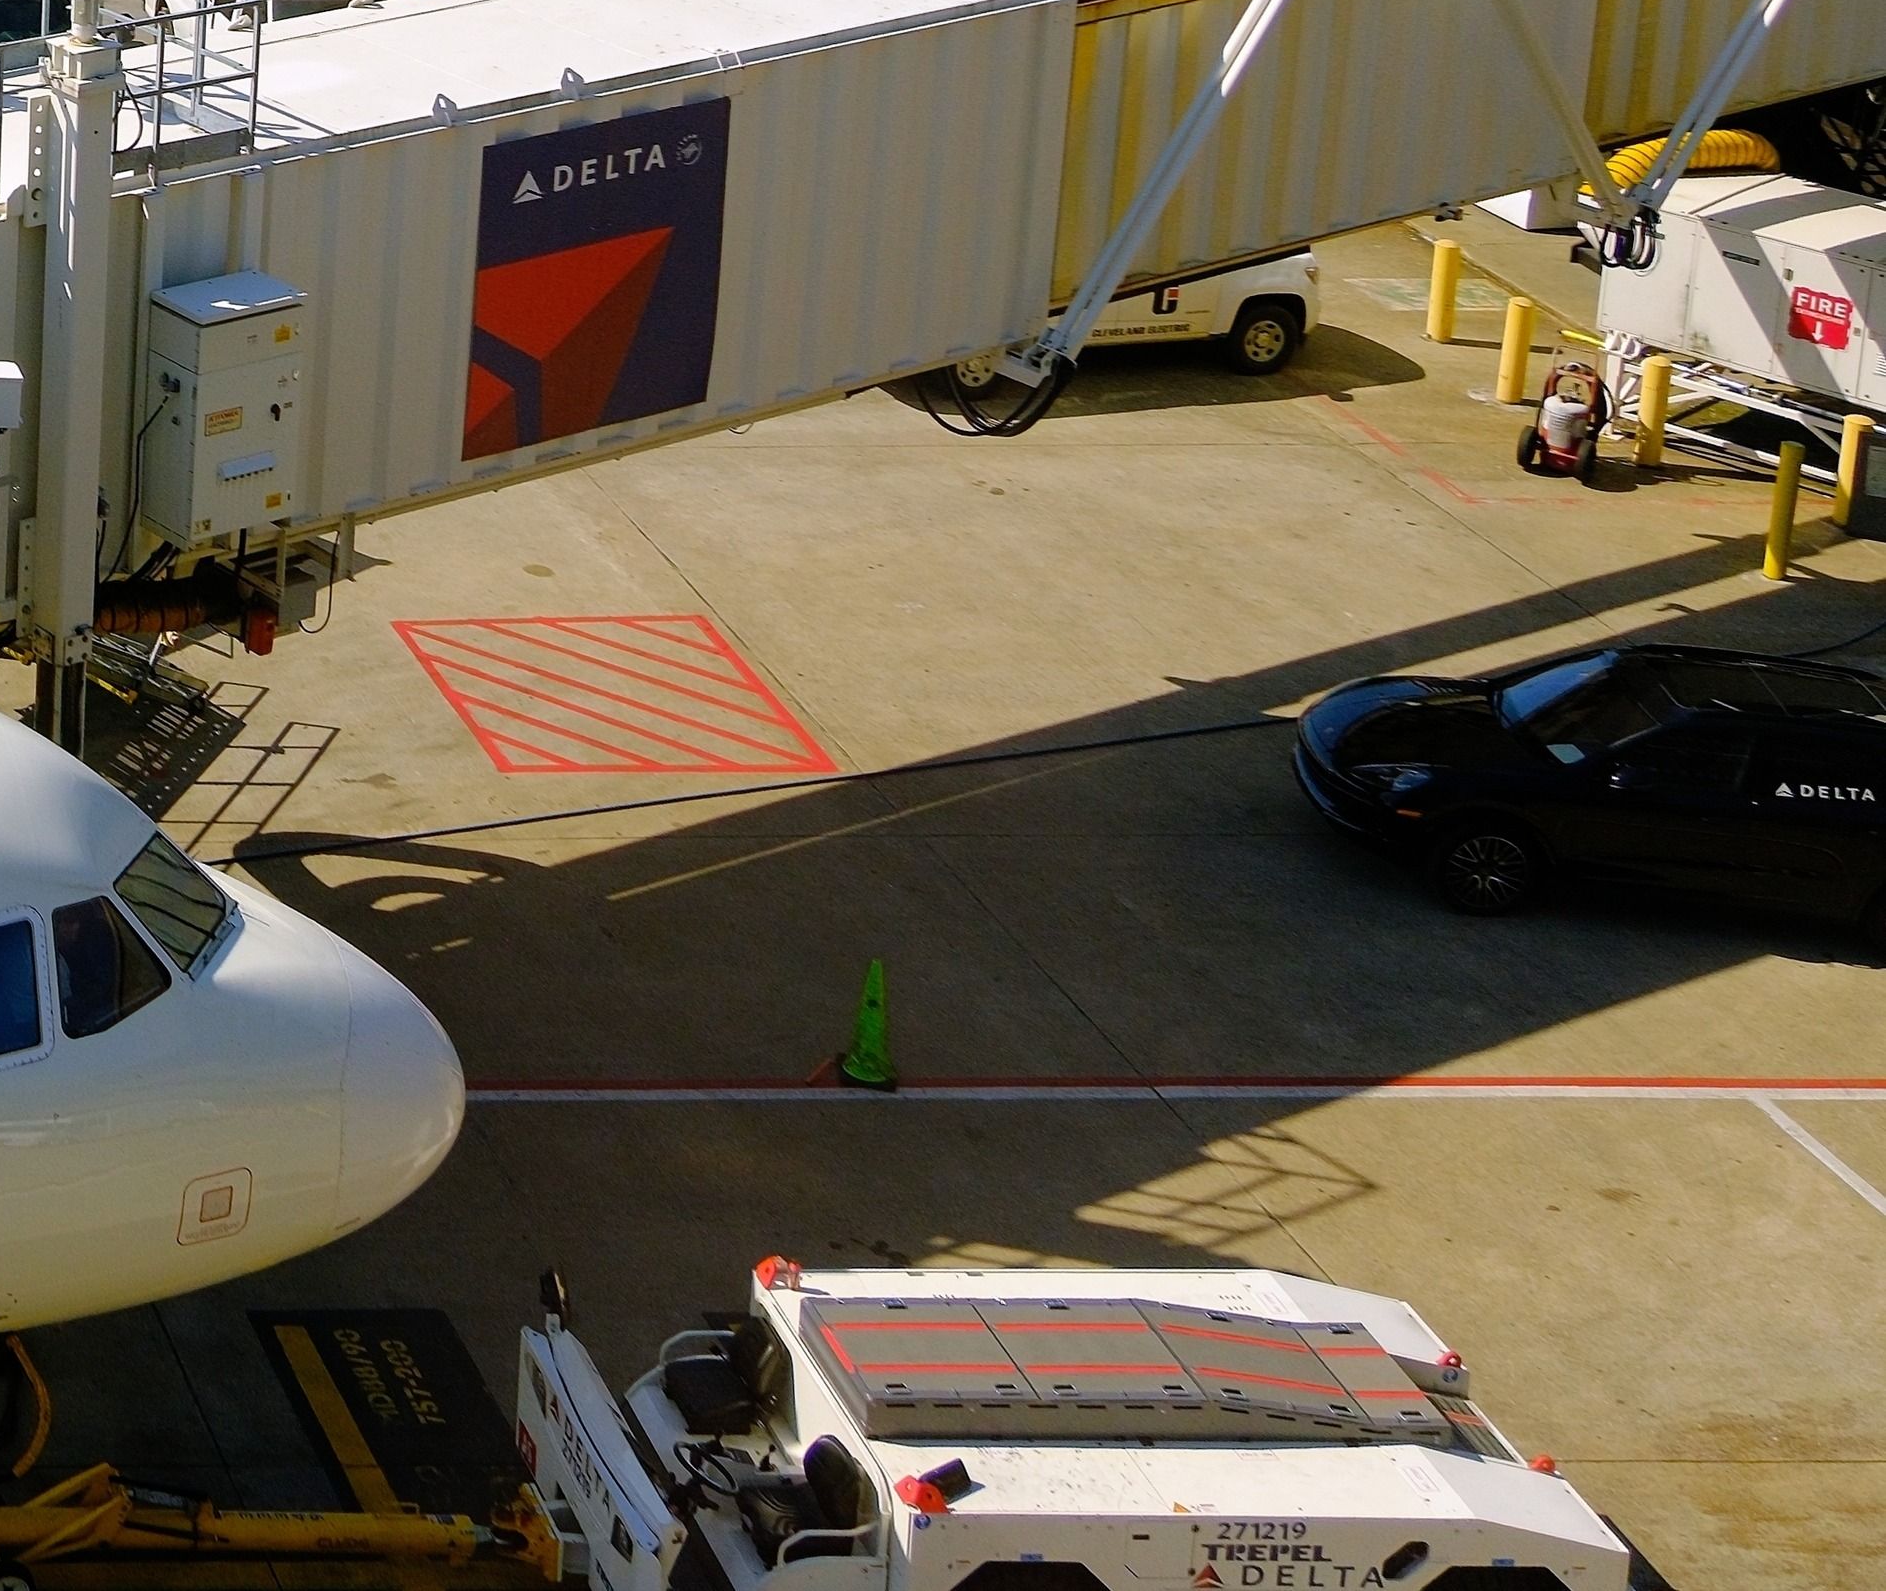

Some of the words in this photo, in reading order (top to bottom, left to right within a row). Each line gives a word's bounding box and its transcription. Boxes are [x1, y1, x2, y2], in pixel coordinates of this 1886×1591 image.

[553, 147, 667, 192] DELTA
[1796, 292, 1848, 319] FIRE
[1091, 327, 1146, 338] CLEVELAND
[1147, 323, 1191, 334] ELECTRIC
[1799, 784, 1876, 801] DELTA
[379, 1339, 446, 1425] 757-200
[565, 1415, 611, 1512] DELTA
[1217, 1523, 1307, 1540] 271219
[1201, 1544, 1332, 1562] TREPEL
[1242, 1564, 1385, 1588] DELTA
